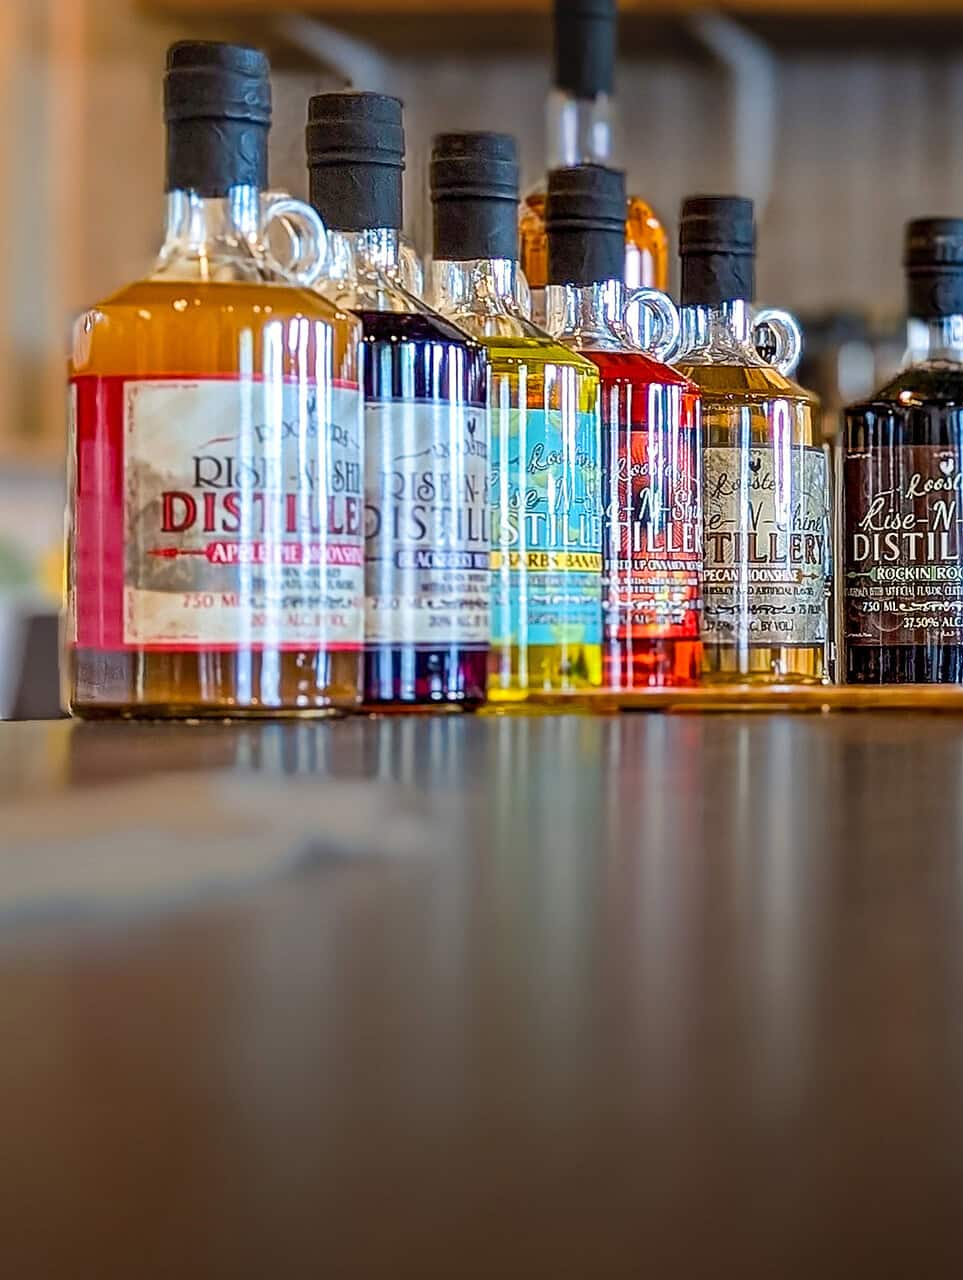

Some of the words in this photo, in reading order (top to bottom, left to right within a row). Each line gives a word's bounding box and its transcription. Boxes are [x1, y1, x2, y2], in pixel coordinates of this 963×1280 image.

[703, 569, 739, 582] PECAN
[876, 566, 931, 581] ROCKIN
[183, 592, 214, 609] 750
[862, 601, 880, 613] 750
